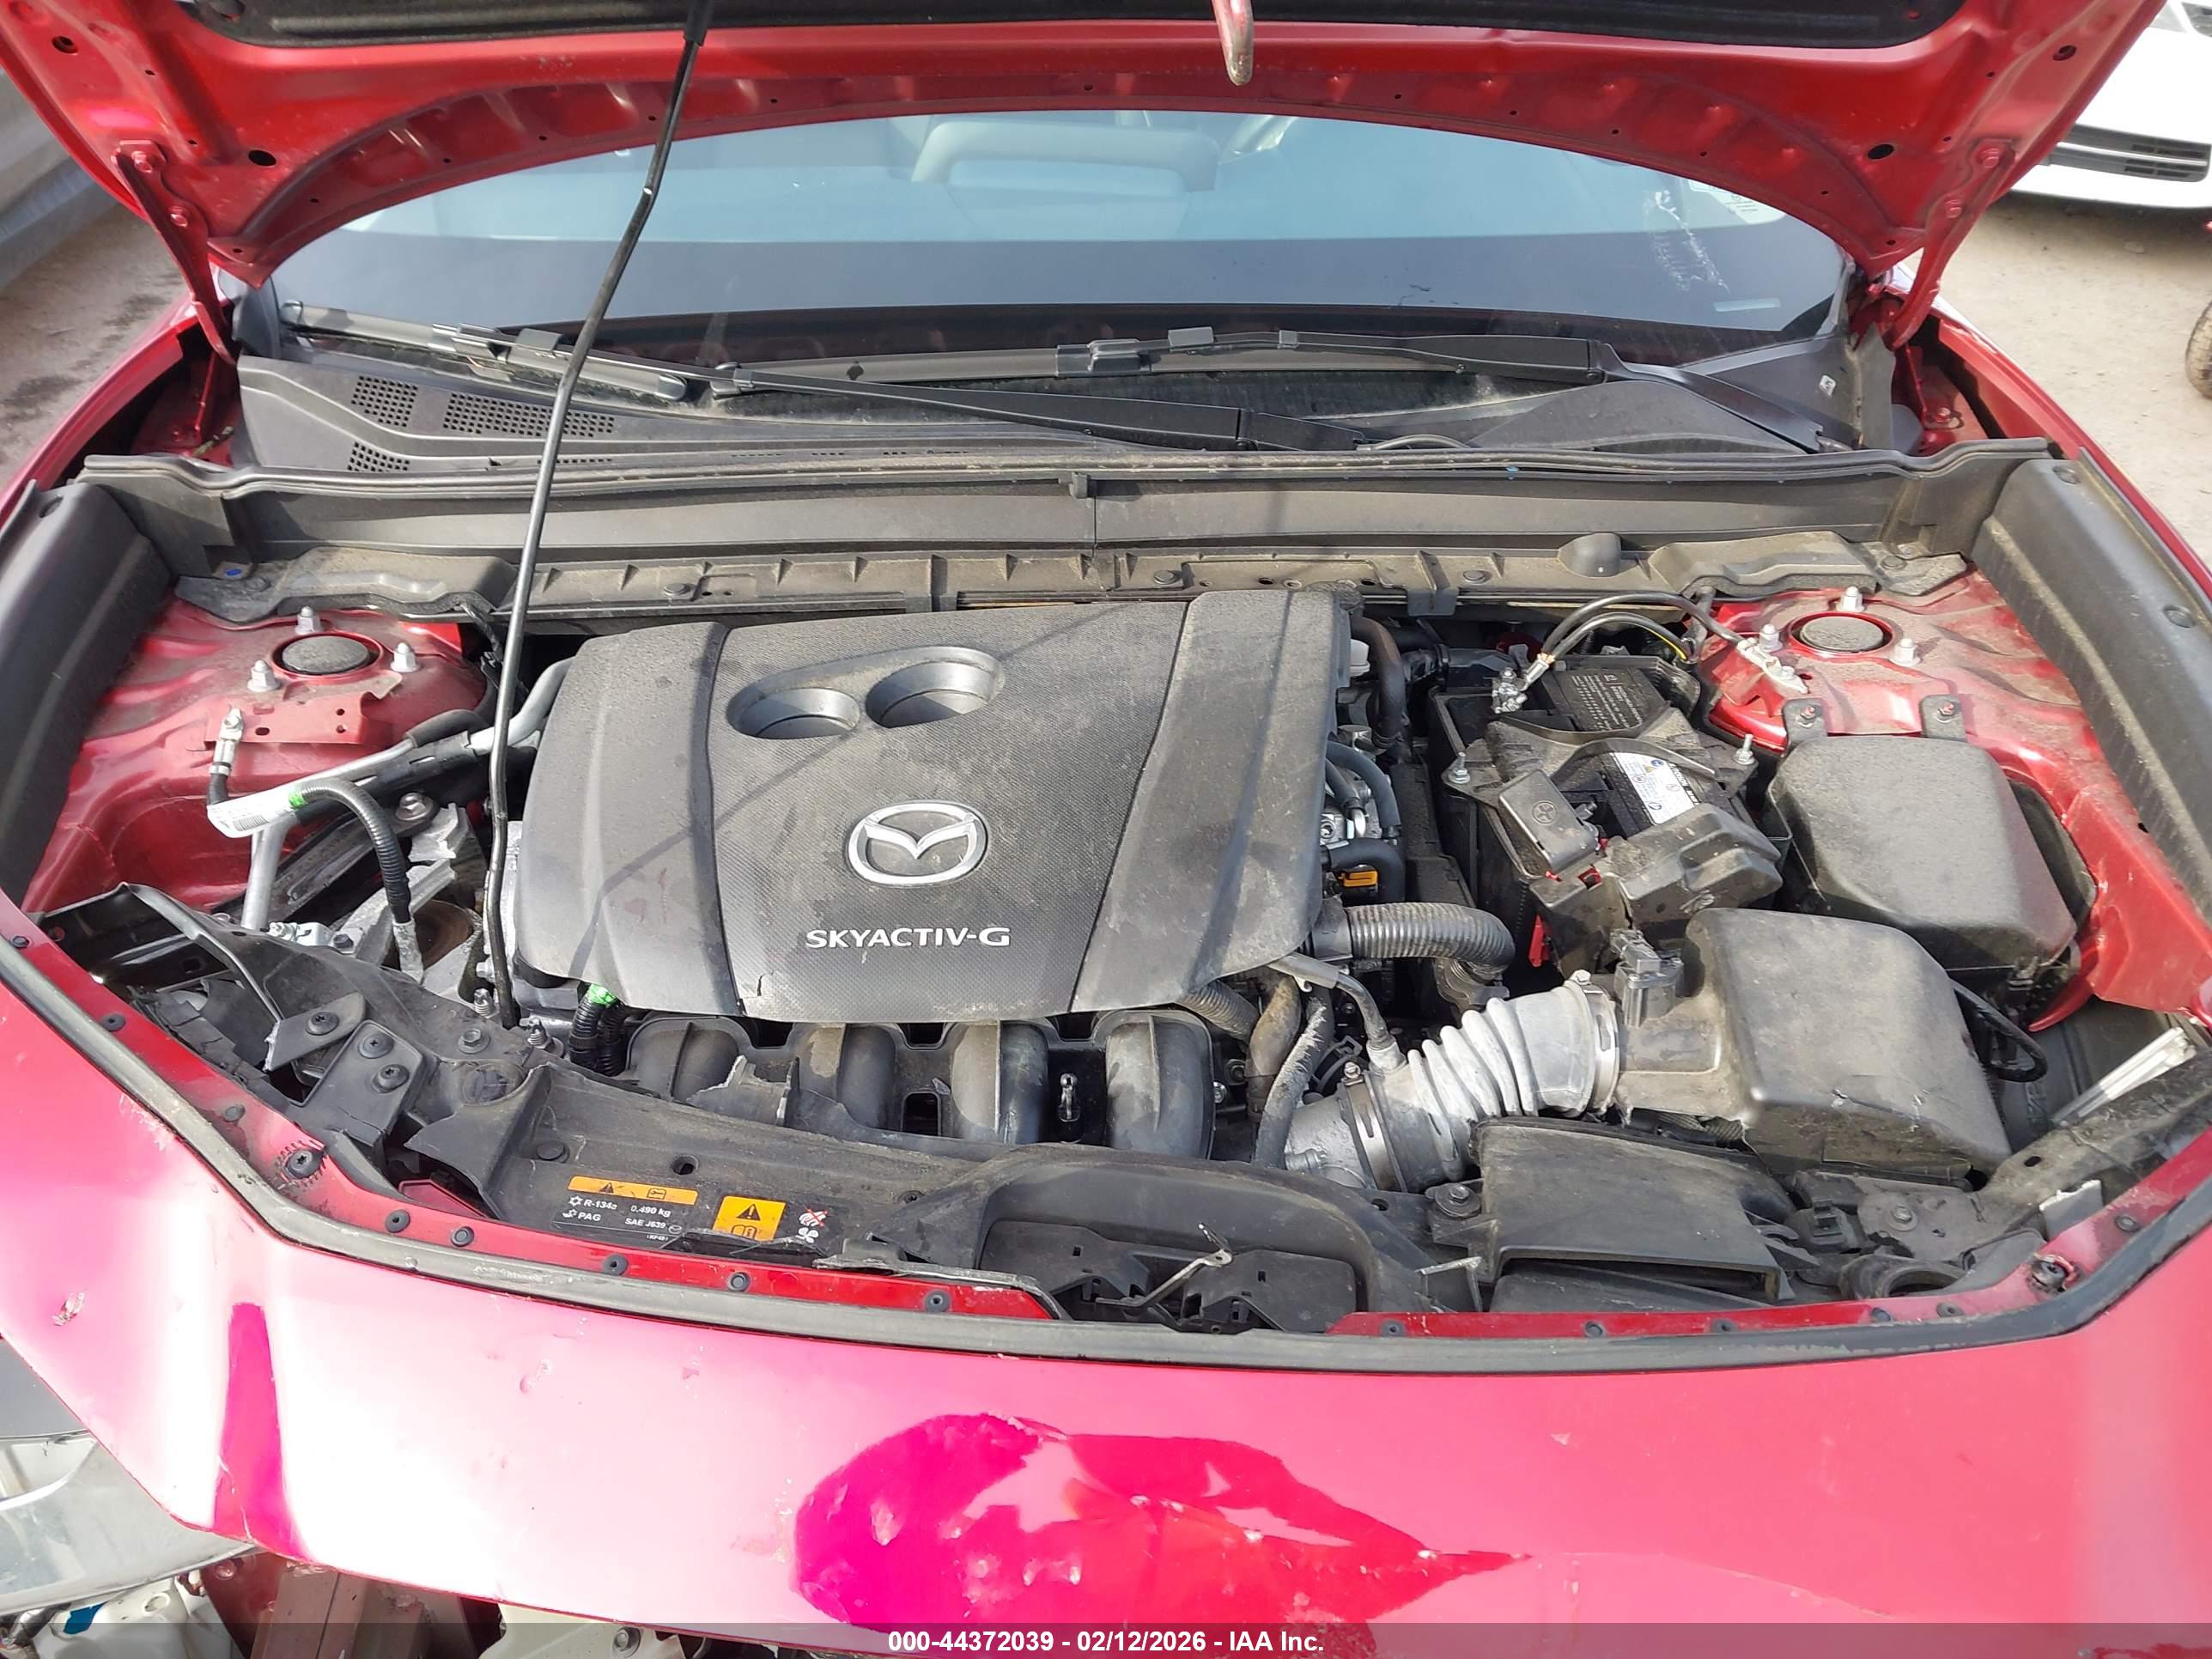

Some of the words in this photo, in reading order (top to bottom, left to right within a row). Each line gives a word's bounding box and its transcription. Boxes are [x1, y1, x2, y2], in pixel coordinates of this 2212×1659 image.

[805, 927, 1012, 949] SKYACTIV-G
[584, 1199, 618, 1210] R-134a
[630, 1205, 658, 1214] 0.490
[658, 1208, 672, 1218] kg
[578, 1212, 602, 1222] PAG
[624, 1218, 645, 1227] SAE
[645, 1219, 666, 1229] J639
